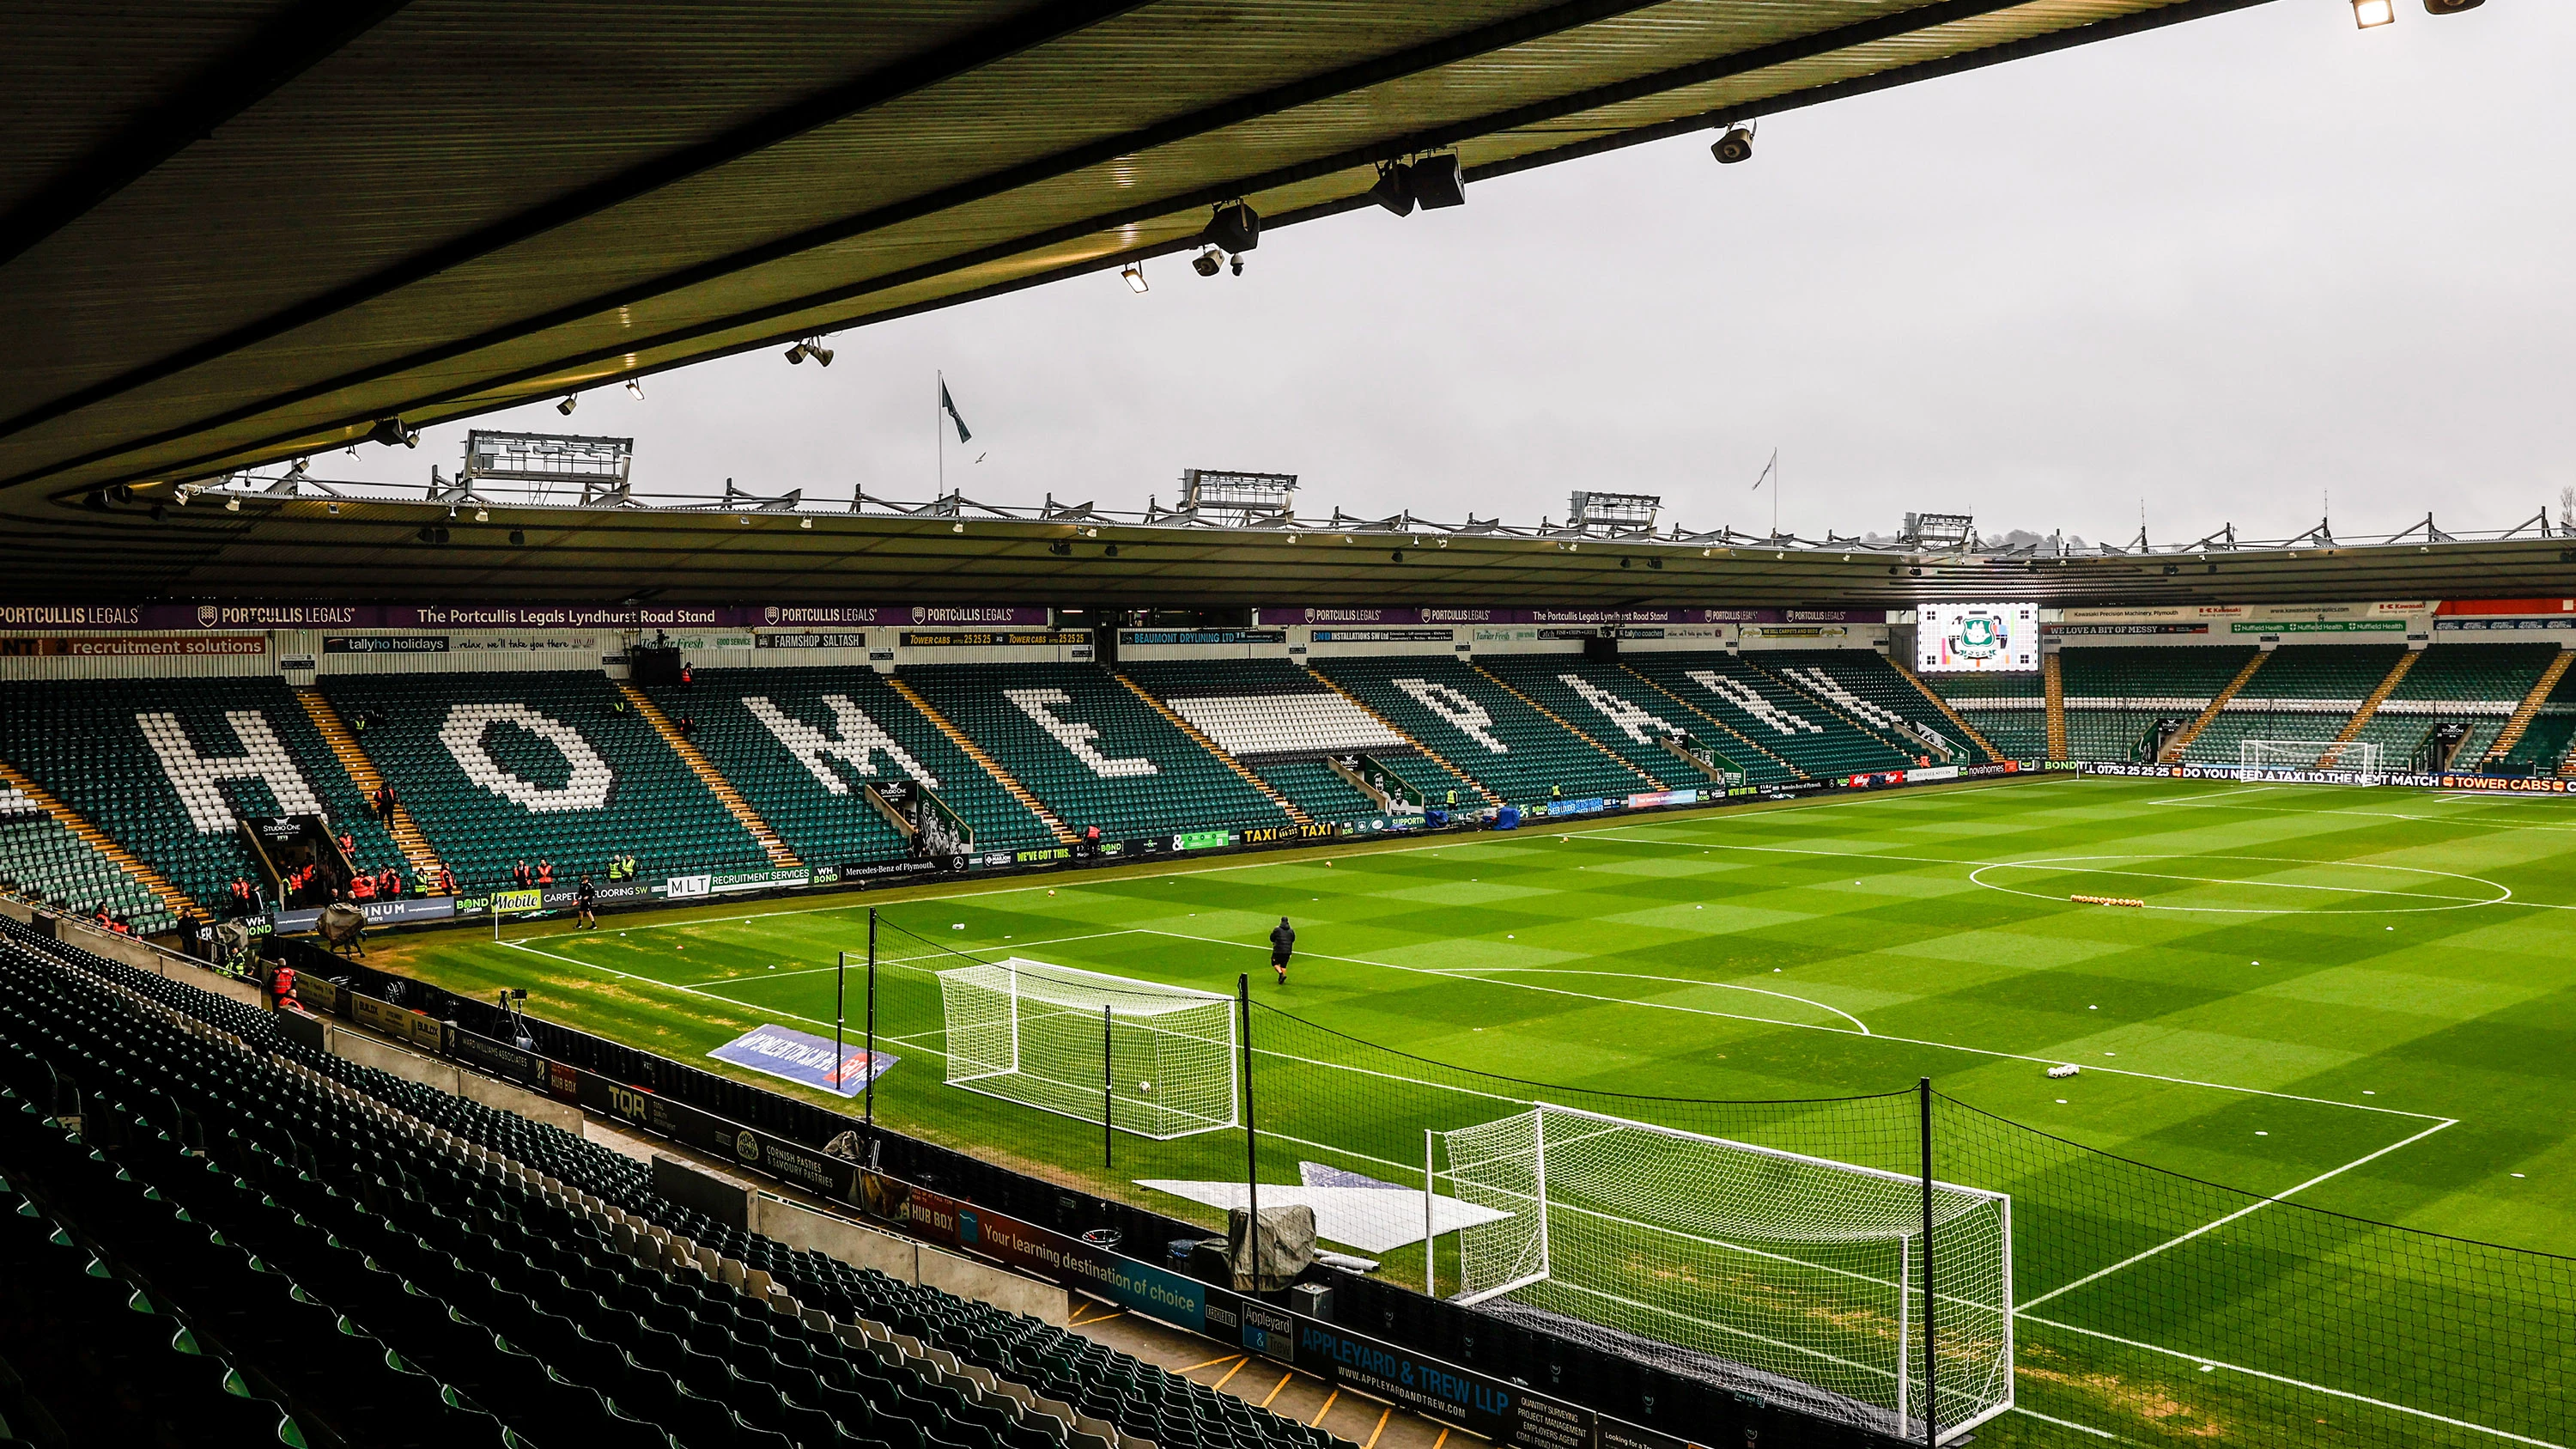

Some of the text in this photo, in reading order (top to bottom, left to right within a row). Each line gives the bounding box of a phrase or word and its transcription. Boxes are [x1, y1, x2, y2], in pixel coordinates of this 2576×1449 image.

[0, 607, 138, 624] PORTCULLIS LEGALS
[222, 607, 352, 623] PORTCULLIS LEGALS
[417, 609, 715, 626] The Portcullis Legals Lyndhurst Road Stand
[782, 608, 875, 622] PORTCULLIS LEGALS
[927, 608, 1012, 621] PORTCULLIS LEGALS
[1316, 609, 1380, 621] PORTCULLIS LEGALS
[1432, 610, 1489, 620] PORTCULLIS LEGALS
[1533, 611, 1668, 623] The Portcullis Legals Road Stand
[1713, 611, 1740, 620] PORTCULLIS
[1795, 611, 1844, 620] PORTCULLIS LEGALS
[1134, 633, 1178, 643] BEAUMONT
[1180, 632, 1219, 642] DRYLINING
[1222, 632, 1234, 642] LTD
[1332, 631, 1389, 642] INSTALLATIONS SW Ltd
[2050, 626, 2064, 636] WE
[2066, 626, 2088, 635] LOVE
[2090, 626, 2097, 635] A
[2099, 626, 2114, 635] BIT
[2128, 625, 2157, 634] MESSY
[349, 637, 444, 651] tallyho holidays
[508, 637, 528, 648] take
[531, 639, 544, 651] you
[547, 637, 569, 648] there
[677, 638, 704, 649] Fresh
[775, 635, 860, 648] FARMSHOP SALTASH
[910, 634, 991, 645] TOWER CABS 25 25 25
[1009, 634, 1030, 643] TOWER
[1031, 635, 1047, 643] CABS
[1059, 634, 1066, 642] 25
[1067, 634, 1075, 642] 25
[1076, 634, 1084, 642] 25
[73, 638, 262, 654] recruitment solutions
[1969, 764, 2004, 775] novahomes
[2044, 761, 2077, 770] BOND
[2097, 765, 2551, 791] 01752 25 25 25 DO YOU NEED A TAXI TO THE NEXT MATCH TOWER CABS
[1245, 828, 1277, 843] TAXI
[1300, 823, 1331, 837] TAXI
[1101, 843, 1121, 852] BOND
[1018, 852, 1036, 862] WE'VE
[1038, 849, 1051, 861] GOT
[817, 866, 833, 875] WH
[846, 865, 893, 876] Mercedes-Benz
[671, 878, 706, 893] MLT
[713, 871, 771, 884] RECRUITMENT
[772, 869, 810, 880] SERVICES
[814, 874, 837, 883] BOND
[635, 886, 648, 895] SW
[456, 898, 489, 910] BOND
[497, 894, 538, 910] Mobile
[246, 916, 265, 927] WH
[247, 924, 272, 936] OND
[359, 1001, 379, 1016] BUILDX
[417, 1021, 439, 1037] BUILDX
[475, 1041, 528, 1068] WILLIAMS ASSOCIATES
[551, 1075, 577, 1093] HUB BOX
[608, 1085, 647, 1121] TQR
[767, 1145, 822, 1173] CORNISH PASTIES
[772, 1157, 802, 1178] SAVOURY
[804, 1167, 833, 1189] PASTRIES
[912, 1204, 954, 1233] HUB BOX
[983, 1223, 1195, 1313] Your learning destination of choice
[1208, 1307, 1234, 1324] ARGYLE TV
[1245, 1306, 1291, 1333] Appleyard
[1256, 1332, 1291, 1355] & Trew
[1302, 1326, 1510, 1416] APPLEYARD & TREW LLP
[1338, 1365, 1466, 1419] WWW.APPLEYARDANDTREW.COM
[1521, 1397, 1578, 1423] QUANTITY SURVEYING
[1517, 1407, 1587, 1438] PROJECT MANAGEMENT
[1516, 1430, 1530, 1443] CDM
[1534, 1435, 1551, 1449] FUND
[1523, 1421, 1579, 1447] EMPLOYERS AGENT
[1605, 1431, 1628, 1446] Looking
[1629, 1439, 1637, 1447] for
